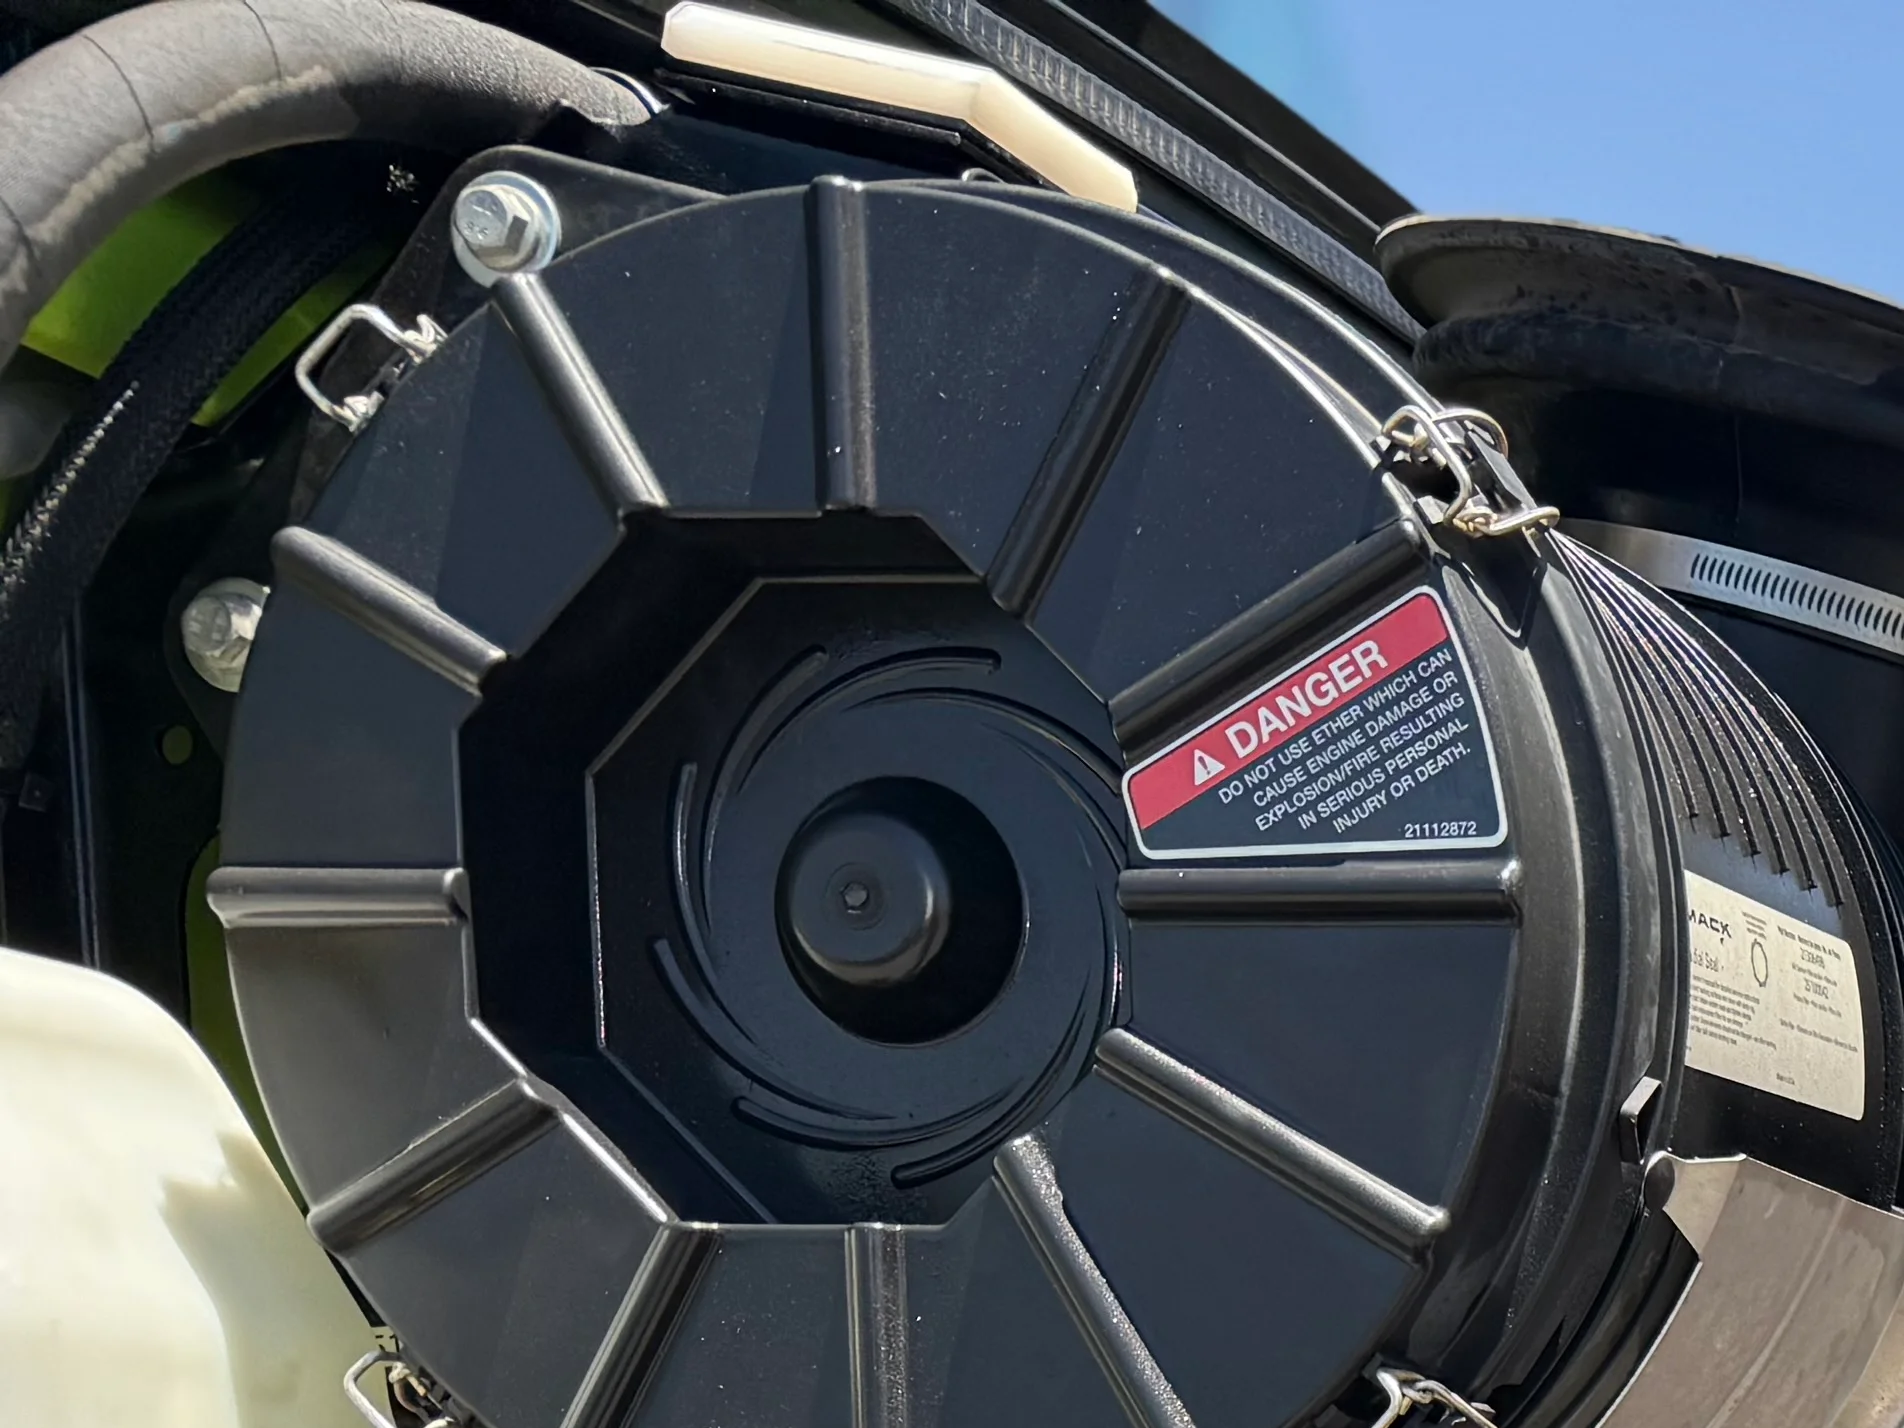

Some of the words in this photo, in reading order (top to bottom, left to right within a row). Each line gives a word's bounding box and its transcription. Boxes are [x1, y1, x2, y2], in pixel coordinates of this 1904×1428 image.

[1218, 781, 1243, 804] DO
[1244, 757, 1276, 787] NOT
[1278, 737, 1312, 765] USE
[1312, 705, 1364, 745] ETHER
[1362, 671, 1417, 712] WHICH
[1418, 648, 1452, 676] CAN
[1225, 640, 1388, 759] DANGER
[1253, 766, 1307, 807] CAUSE
[1306, 729, 1366, 774] ENGINE
[1365, 687, 1433, 737] DAMAGE
[1433, 671, 1458, 693] OR
[1255, 745, 1380, 831] EXPLOSION/FIRE
[1380, 693, 1464, 751] RESULTING
[1298, 810, 1317, 829] IN
[1317, 768, 1385, 817] SERIOUS
[1385, 717, 1469, 774] PERSONAL
[1332, 790, 1387, 833] INJURY
[1390, 775, 1415, 798] OR
[1415, 742, 1470, 782] DEATH.
[1404, 821, 1477, 838] 21112872
